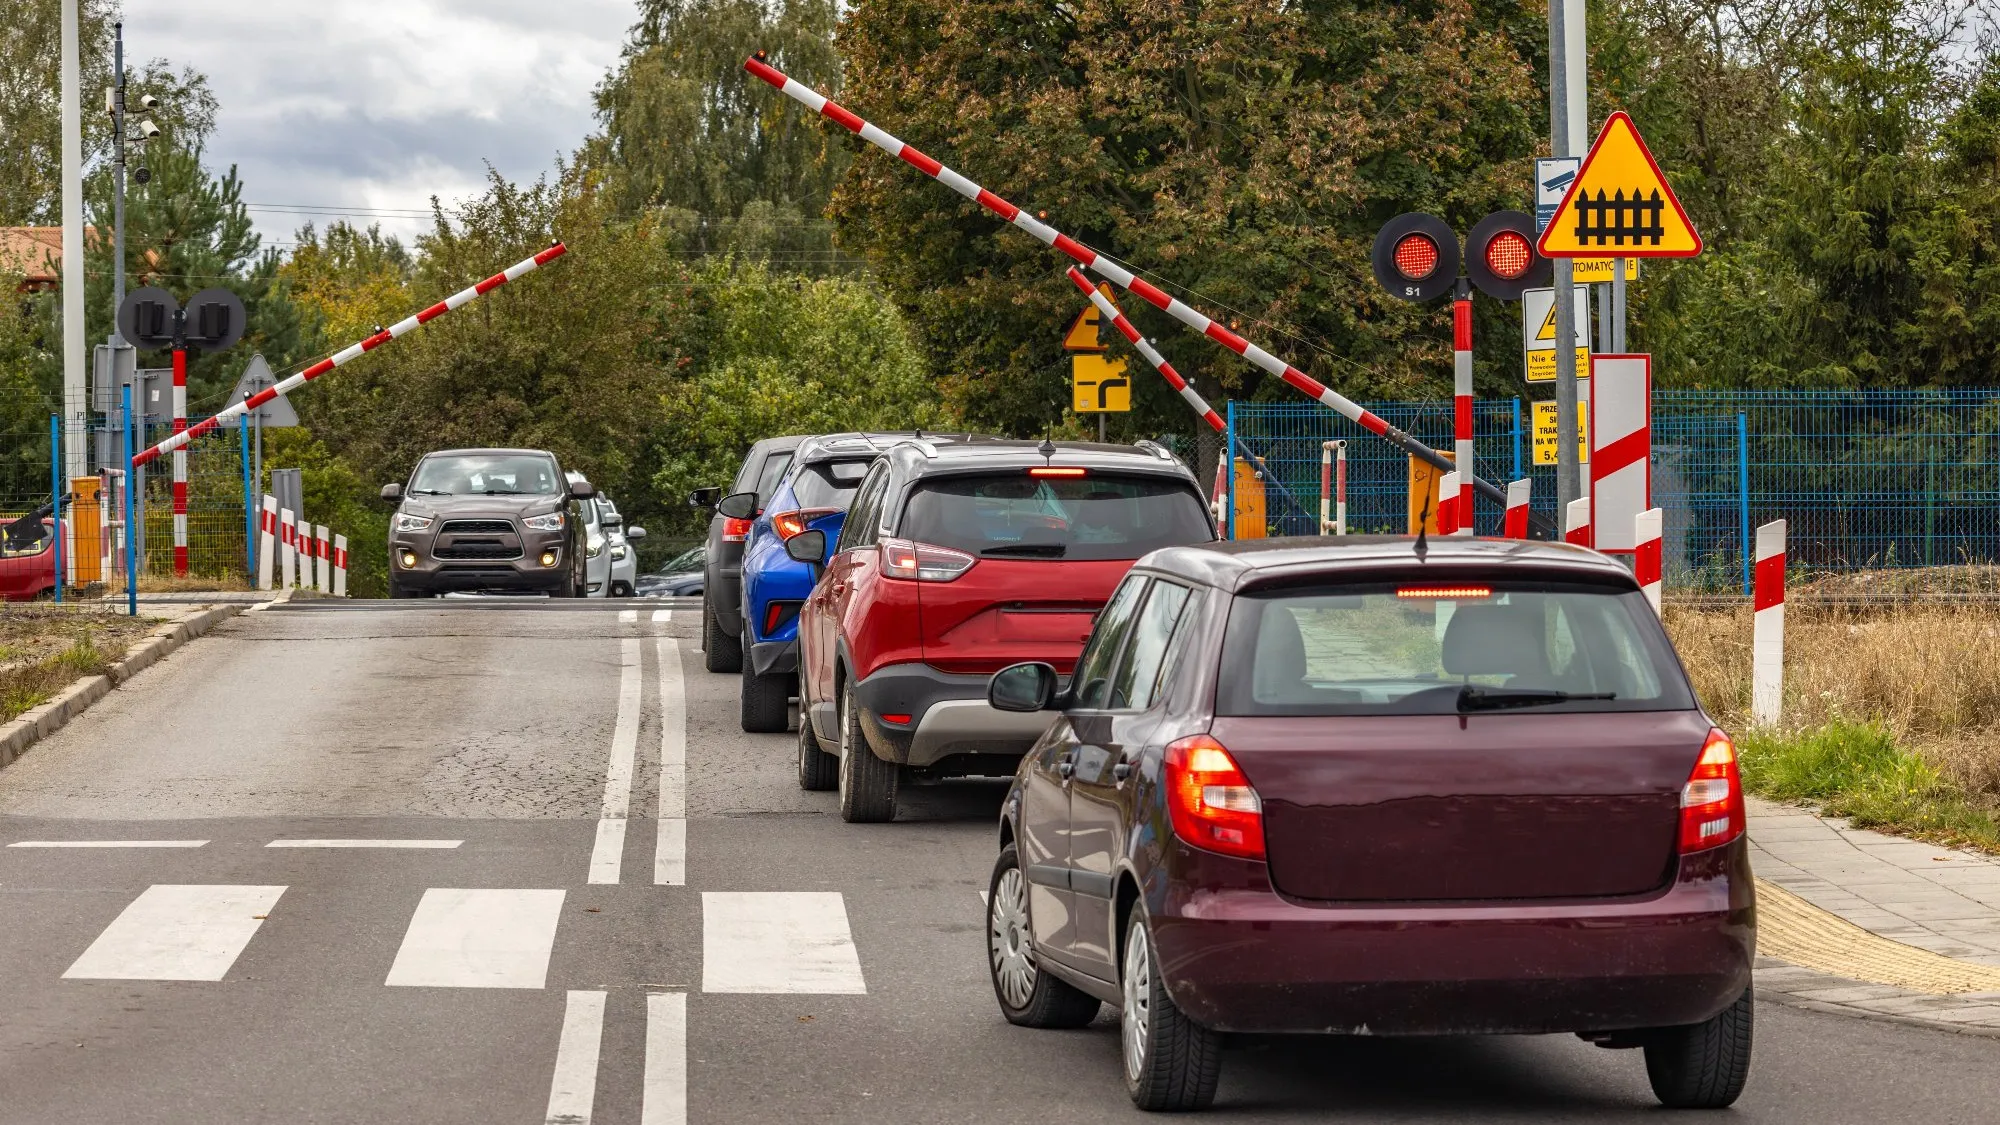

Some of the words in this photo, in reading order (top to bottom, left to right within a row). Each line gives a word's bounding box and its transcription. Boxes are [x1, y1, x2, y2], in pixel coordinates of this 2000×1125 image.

[1573, 260, 1634, 272] TOMATYCIE
[1405, 286, 1420, 297] S1
[1531, 354, 1546, 363] Nie
[1540, 405, 1558, 413] PRZE
[1535, 437, 1545, 445] NA
[1544, 450, 1558, 461] 5,4
